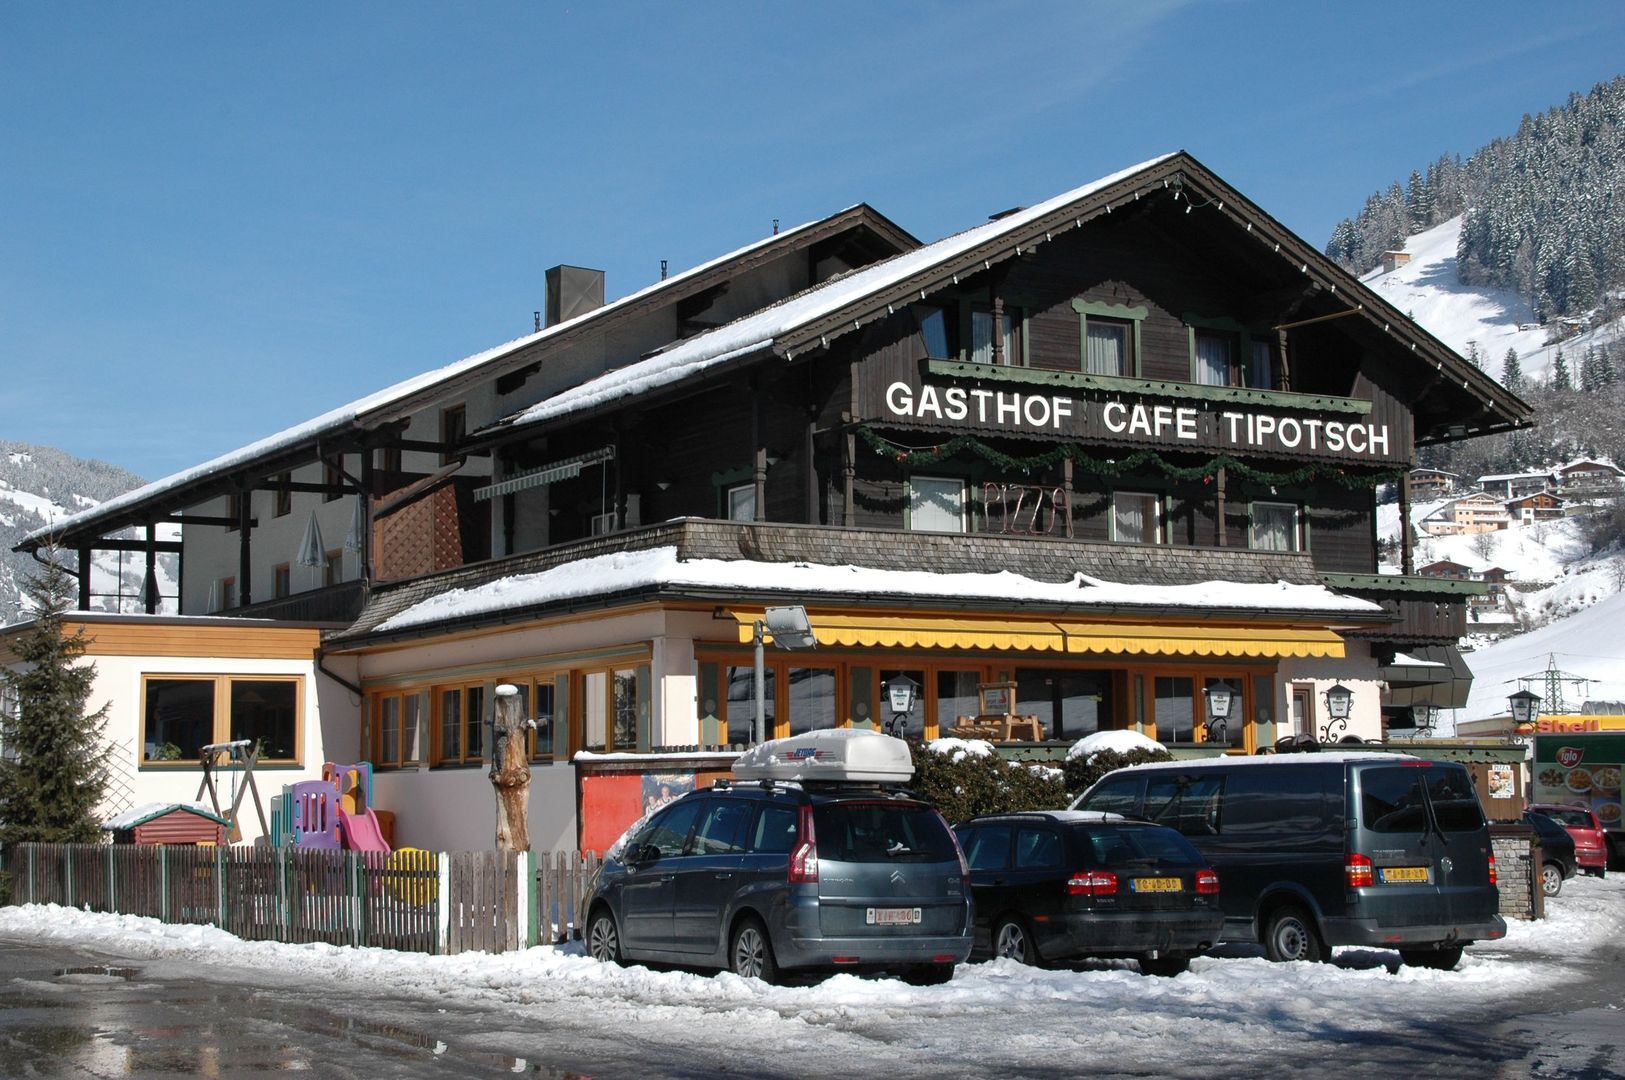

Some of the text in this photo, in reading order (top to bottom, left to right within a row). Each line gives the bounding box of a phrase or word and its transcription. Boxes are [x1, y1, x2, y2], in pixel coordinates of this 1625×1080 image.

[885, 381, 1389, 456] GASTHOF CAFE TIPOTSCH
[983, 481, 1074, 539] PIZZA
[1537, 719, 1599, 733] Shell
[1561, 750, 1578, 764] iglo
